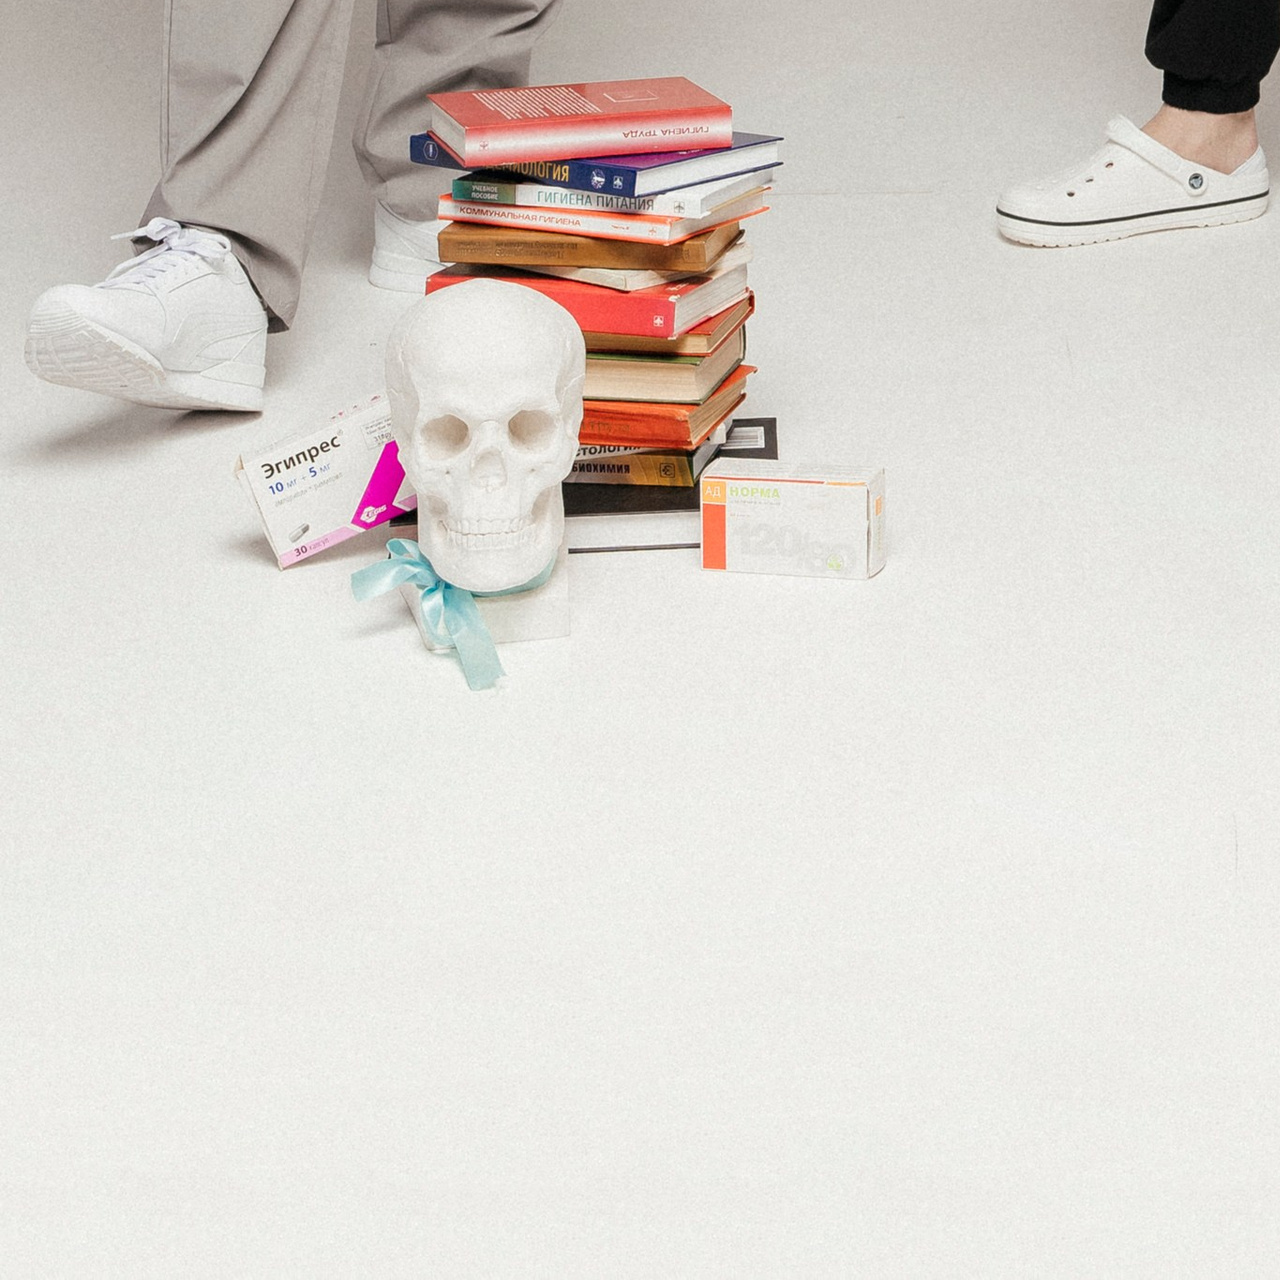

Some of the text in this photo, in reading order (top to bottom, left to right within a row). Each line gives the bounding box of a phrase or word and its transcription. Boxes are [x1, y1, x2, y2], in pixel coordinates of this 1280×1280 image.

[622, 125, 710, 139] ГИГИЕНА ТРУДА
[485, 161, 570, 183] ИОЛОГИЯ
[471, 184, 499, 194] УЧЕБНОЕ
[471, 192, 499, 201] ПОСОБИЕ
[537, 191, 655, 211] ГИГИЕНА ПИТАНИЯ
[459, 206, 581, 227] КОММУНАЛЬНАЯ ГИГИЕНА
[261, 436, 341, 480] Эгипрес
[575, 446, 641, 457] ТОЛОГ
[572, 462, 631, 474] БИОХИМИЯ
[268, 481, 284, 496] 10
[286, 478, 298, 490] мг
[308, 466, 318, 478] 5
[319, 462, 331, 475] мг
[704, 485, 781, 499] АД НОРМА
[293, 545, 308, 557] 30
